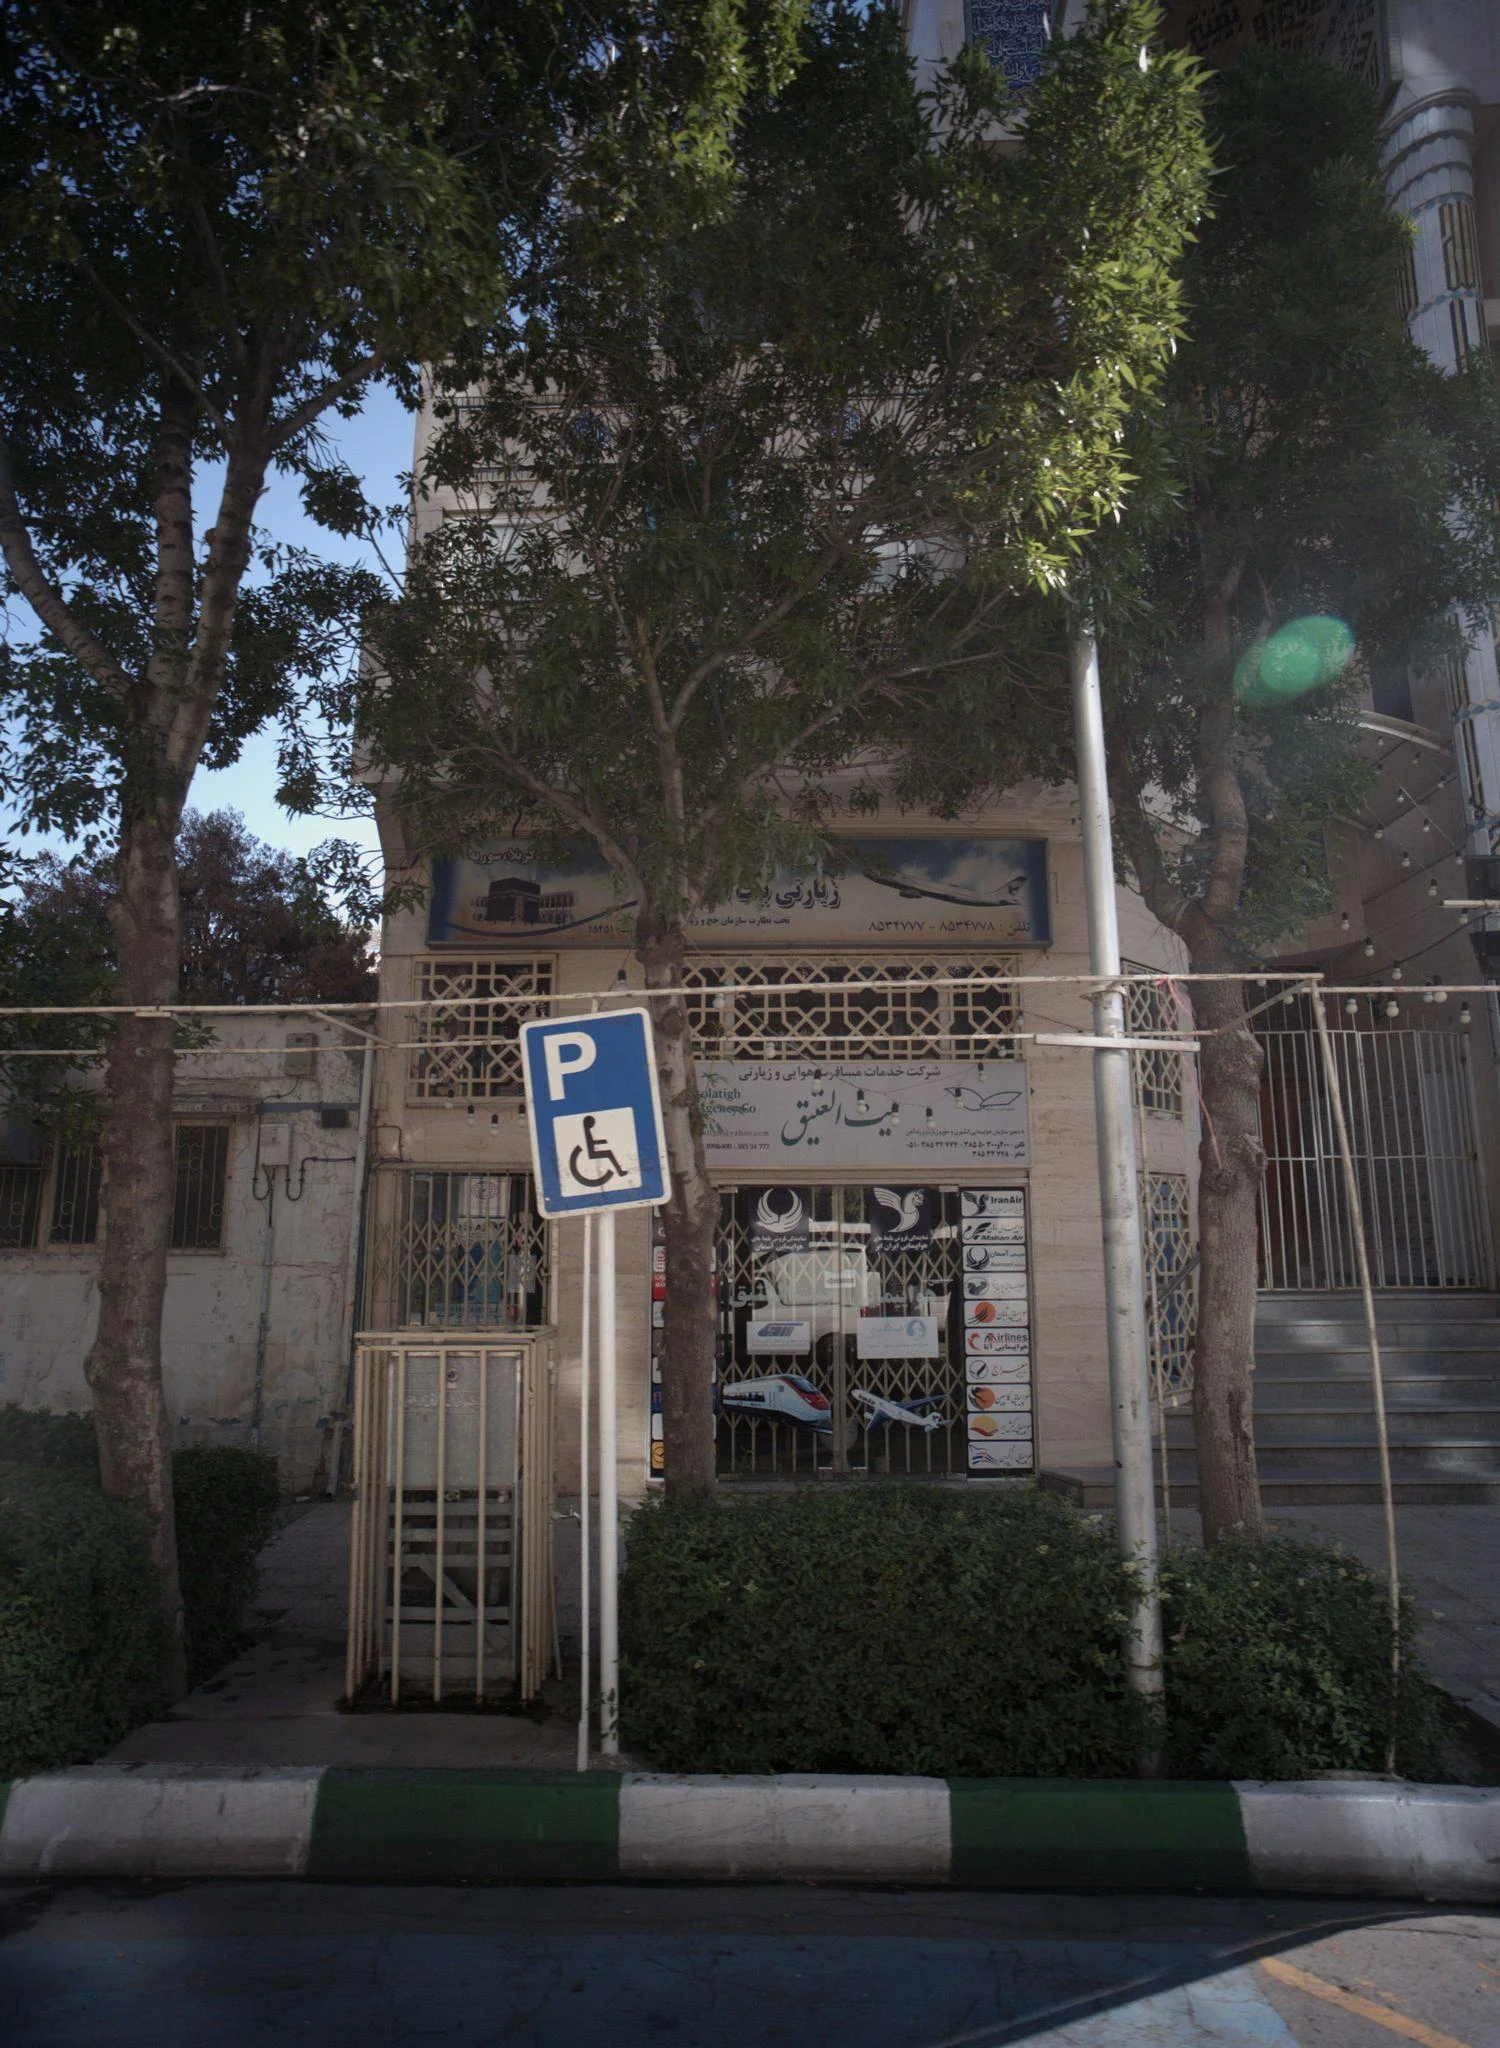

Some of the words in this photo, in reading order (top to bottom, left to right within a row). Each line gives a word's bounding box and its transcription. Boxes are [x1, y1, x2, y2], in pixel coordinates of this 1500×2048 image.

[775, 877, 842, 909] زیارتی
[706, 917, 719, 926] حج
[721, 915, 746, 926] سازمان
[748, 915, 772, 926] نظارت
[773, 915, 790, 925] تحت
[868, 919, 926, 932] ۸۵۳۴۷۷۷
[940, 919, 995, 932] ۸۵۳۴۷۷۸
[1007, 919, 1031, 936] تلفن
[543, 1031, 597, 1101] P
[863, 1065, 905, 1077] خدمات
[906, 1065, 941, 1080] شرکت
[739, 1065, 772, 1081] زیارتی
[774, 1069, 780, 1081] و
[783, 1066, 814, 1081] هوایی
[781, 1087, 842, 1146] العتیق
[845, 1102, 897, 1137] یت
[991, 1196, 1023, 1204] IranAir
